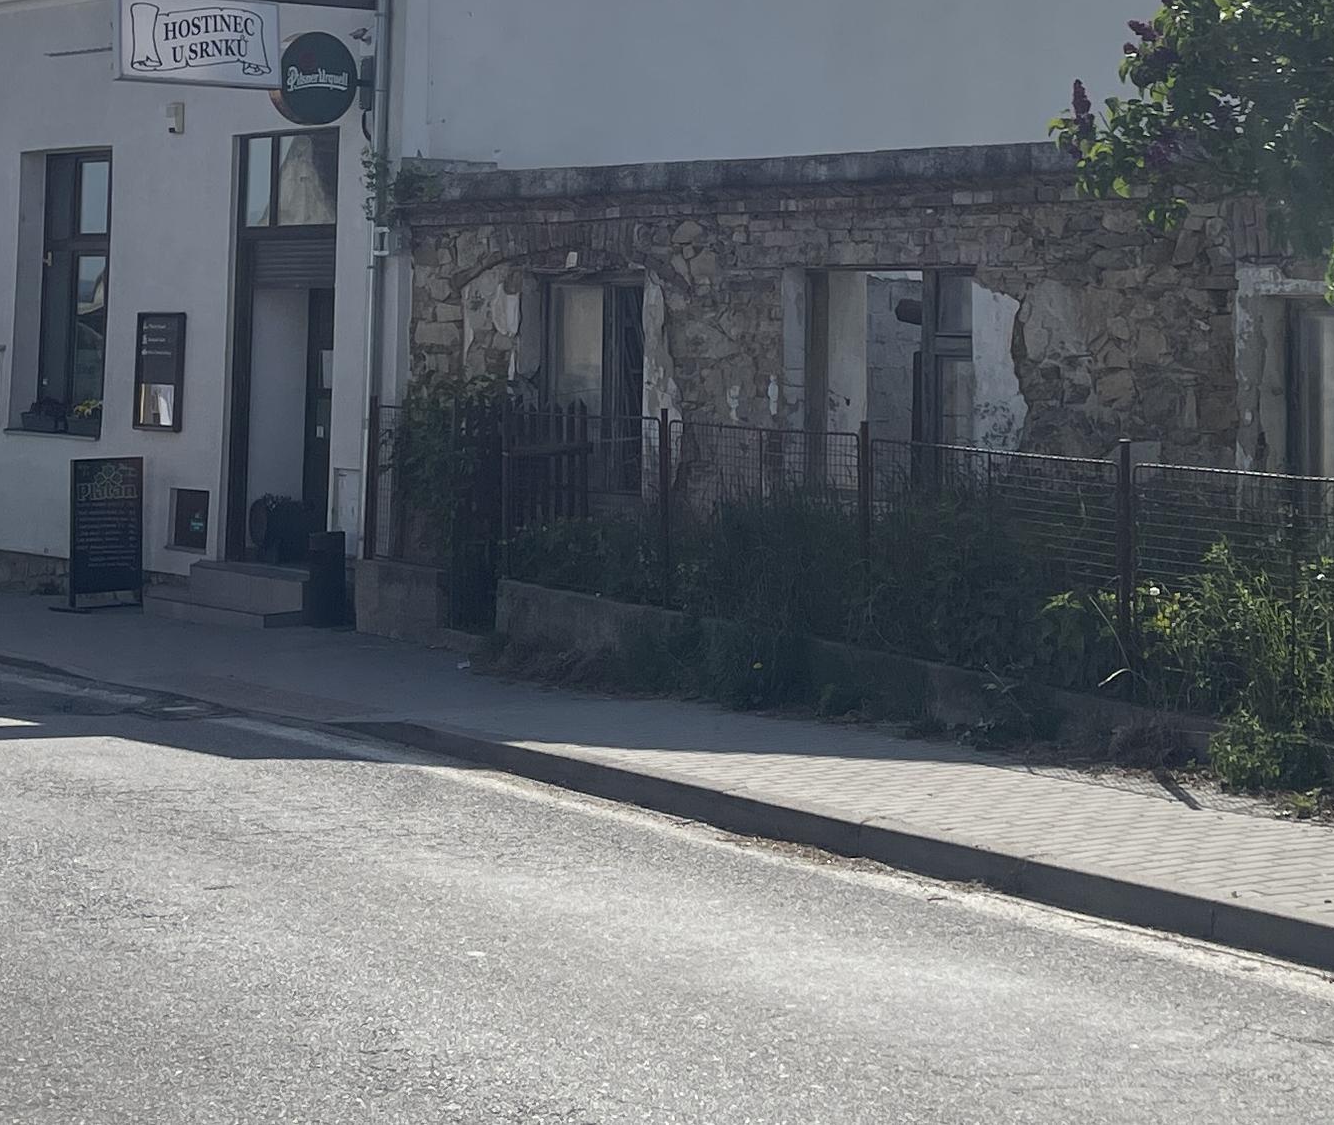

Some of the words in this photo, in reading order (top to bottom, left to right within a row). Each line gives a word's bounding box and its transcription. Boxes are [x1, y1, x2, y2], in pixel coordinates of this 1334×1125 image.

[163, 14, 255, 41] HOSTINEC
[171, 45, 185, 63] U
[188, 34, 249, 61] SRNKŮ
[286, 66, 319, 92] Pilsner
[317, 68, 349, 91] Urquell
